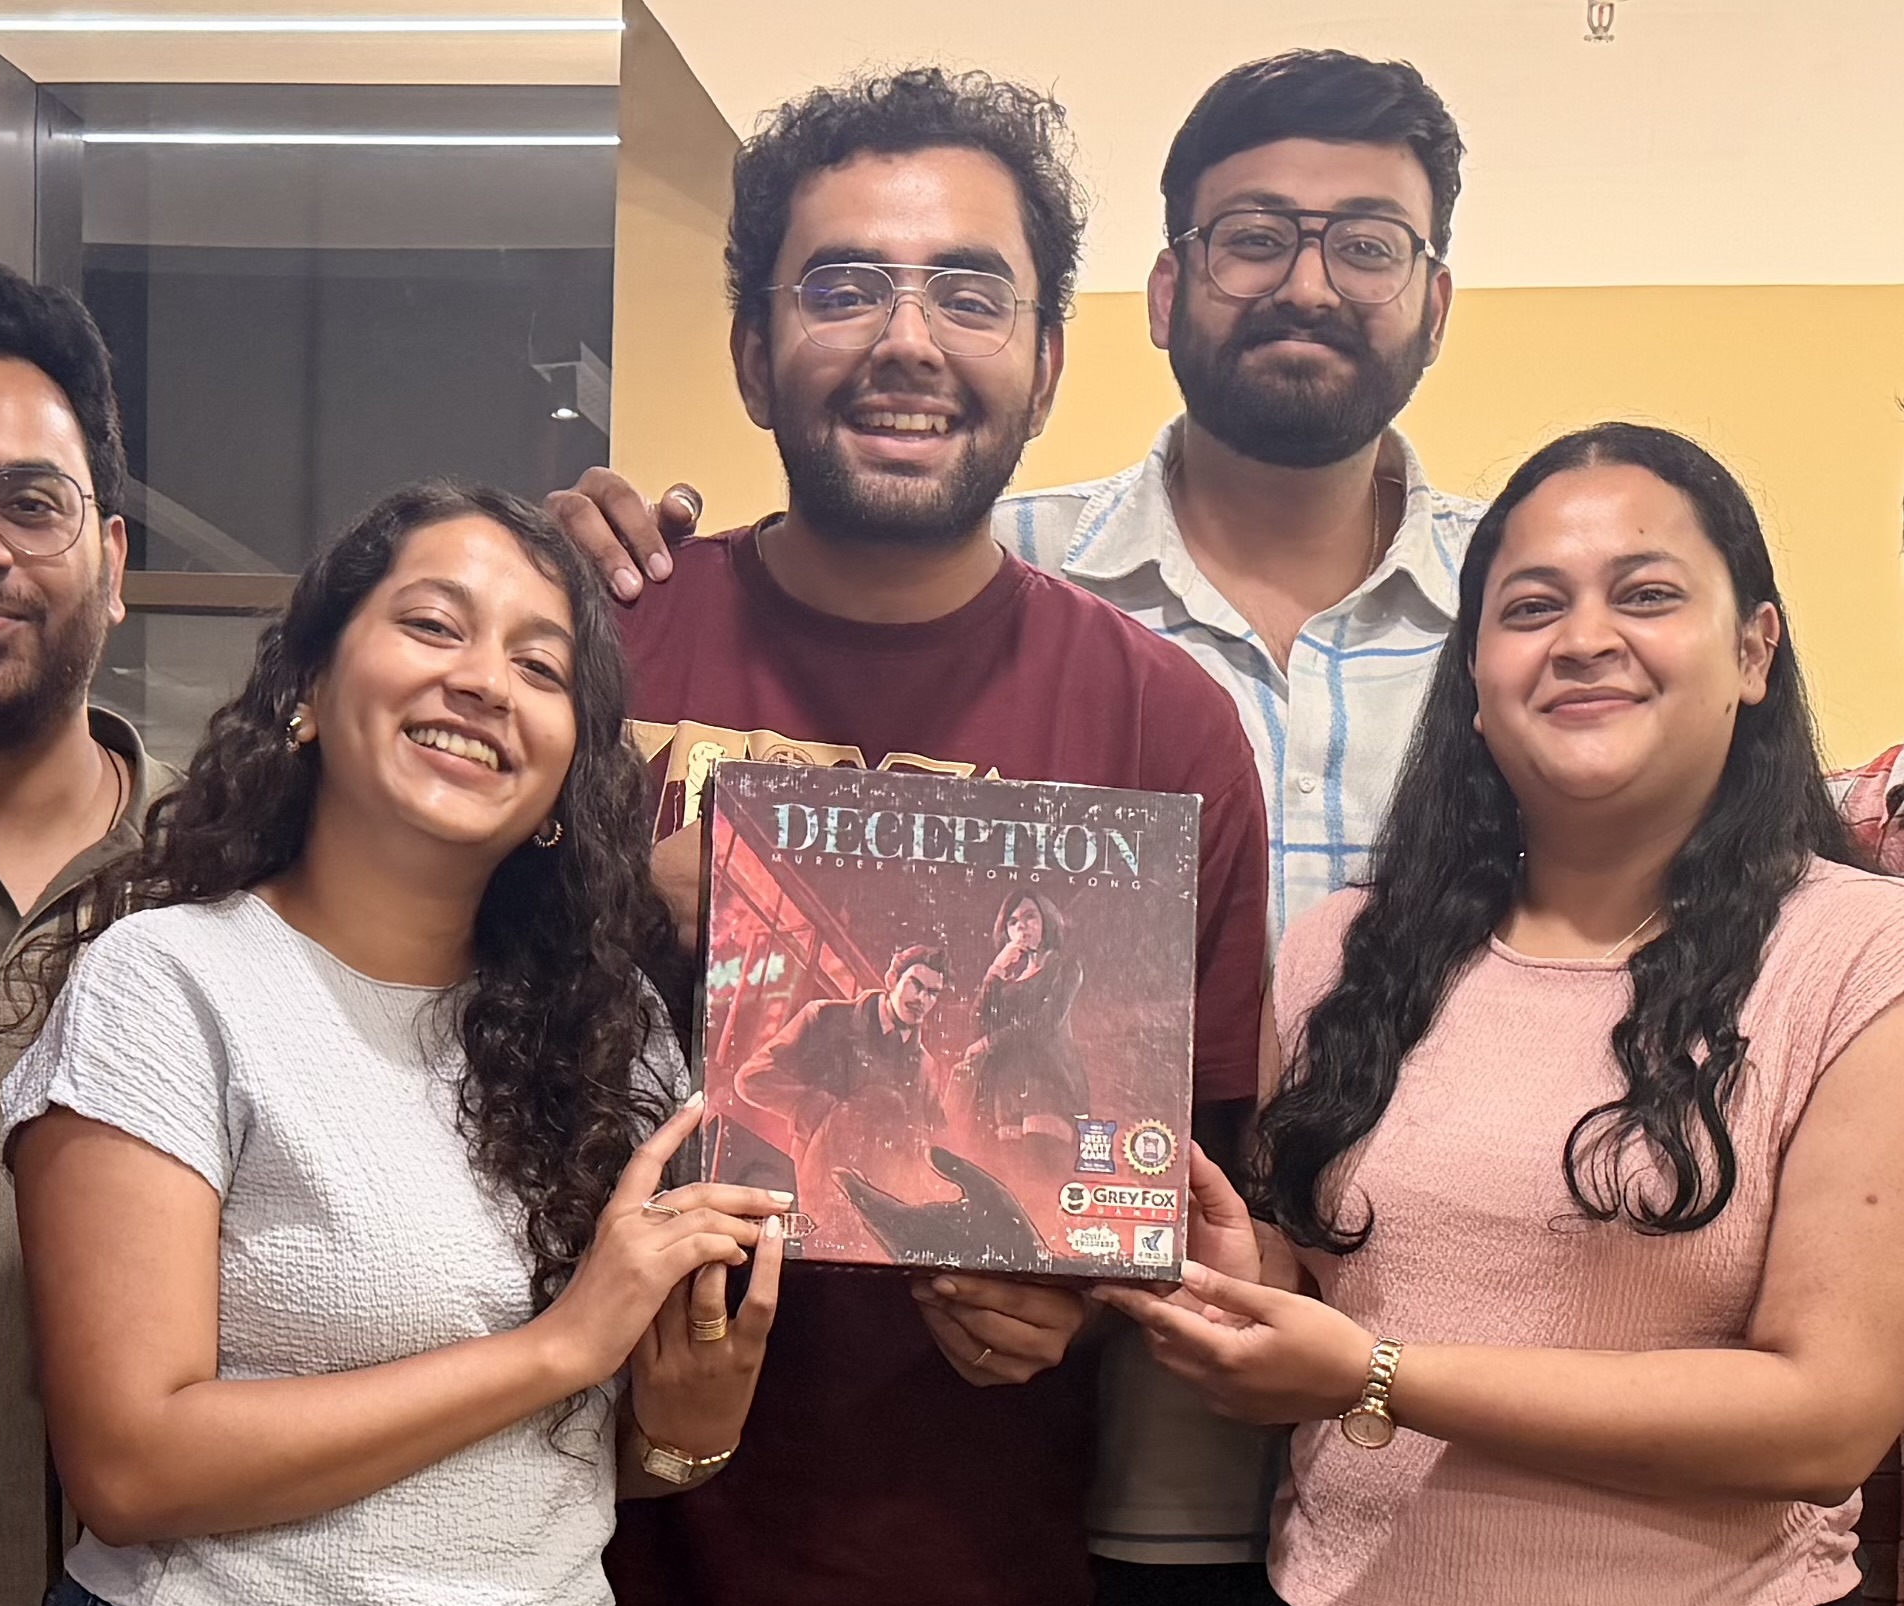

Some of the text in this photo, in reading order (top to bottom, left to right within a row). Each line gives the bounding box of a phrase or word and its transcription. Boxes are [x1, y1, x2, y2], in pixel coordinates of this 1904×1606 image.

[772, 803, 1145, 877] DECEPTION
[771, 853, 1142, 890] MURDER IN HONG KONG
